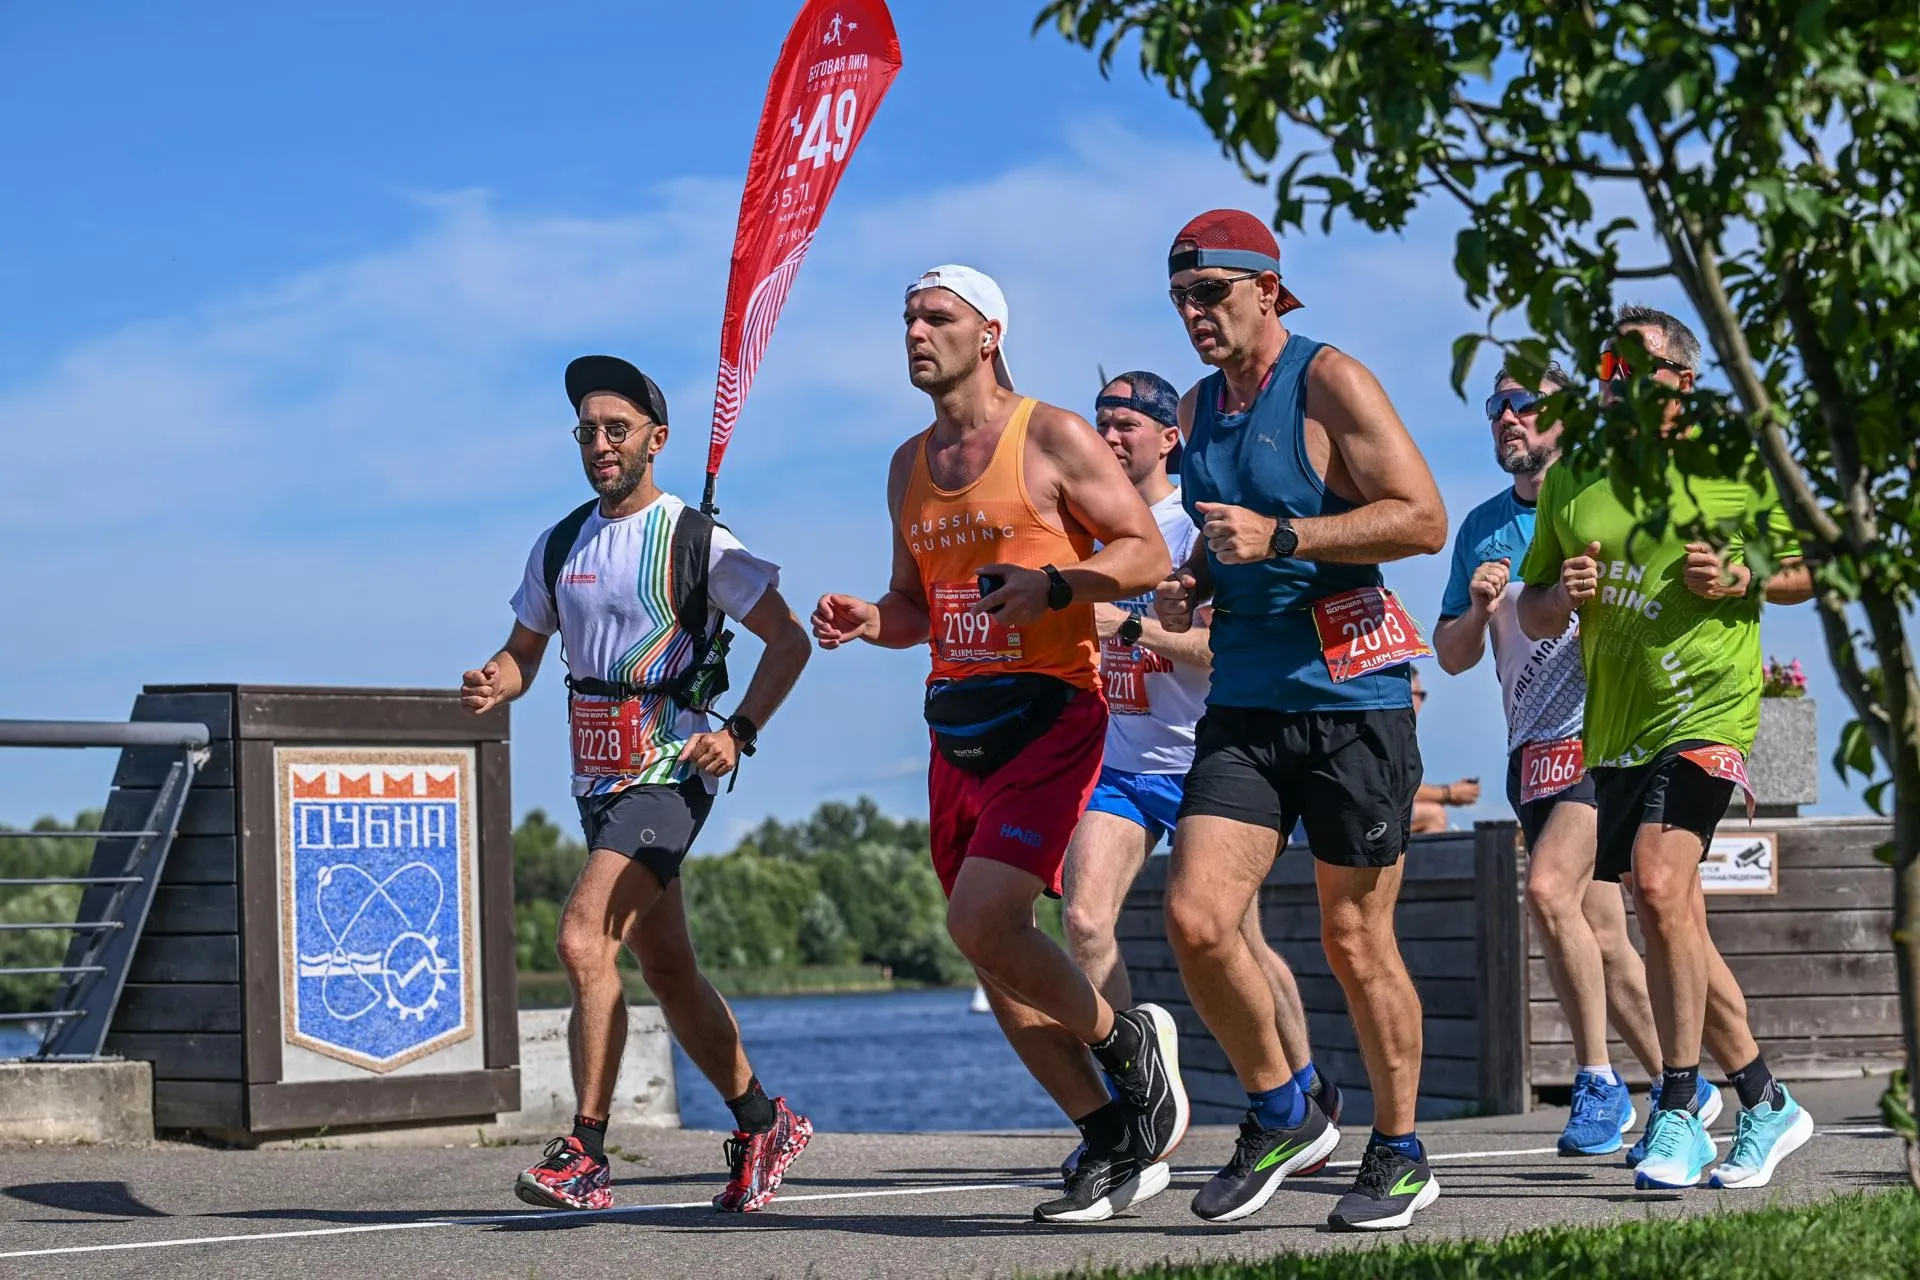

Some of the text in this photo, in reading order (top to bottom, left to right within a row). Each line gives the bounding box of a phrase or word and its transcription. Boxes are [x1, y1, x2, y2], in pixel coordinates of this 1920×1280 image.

[848, 53, 868, 70] ЛИГА
[781, 88, 858, 181] :49
[911, 510, 986, 537] RUSSIA
[912, 526, 1015, 555] RUNNING
[1601, 585, 1664, 621] RING
[943, 611, 990, 644] 2199
[1342, 612, 1407, 659] 2013
[1107, 670, 1135, 700] 2211
[1513, 664, 1536, 702] HALF
[578, 727, 622, 761] 2228
[1529, 753, 1576, 787] 2066
[297, 803, 447, 850] ДУБНА
